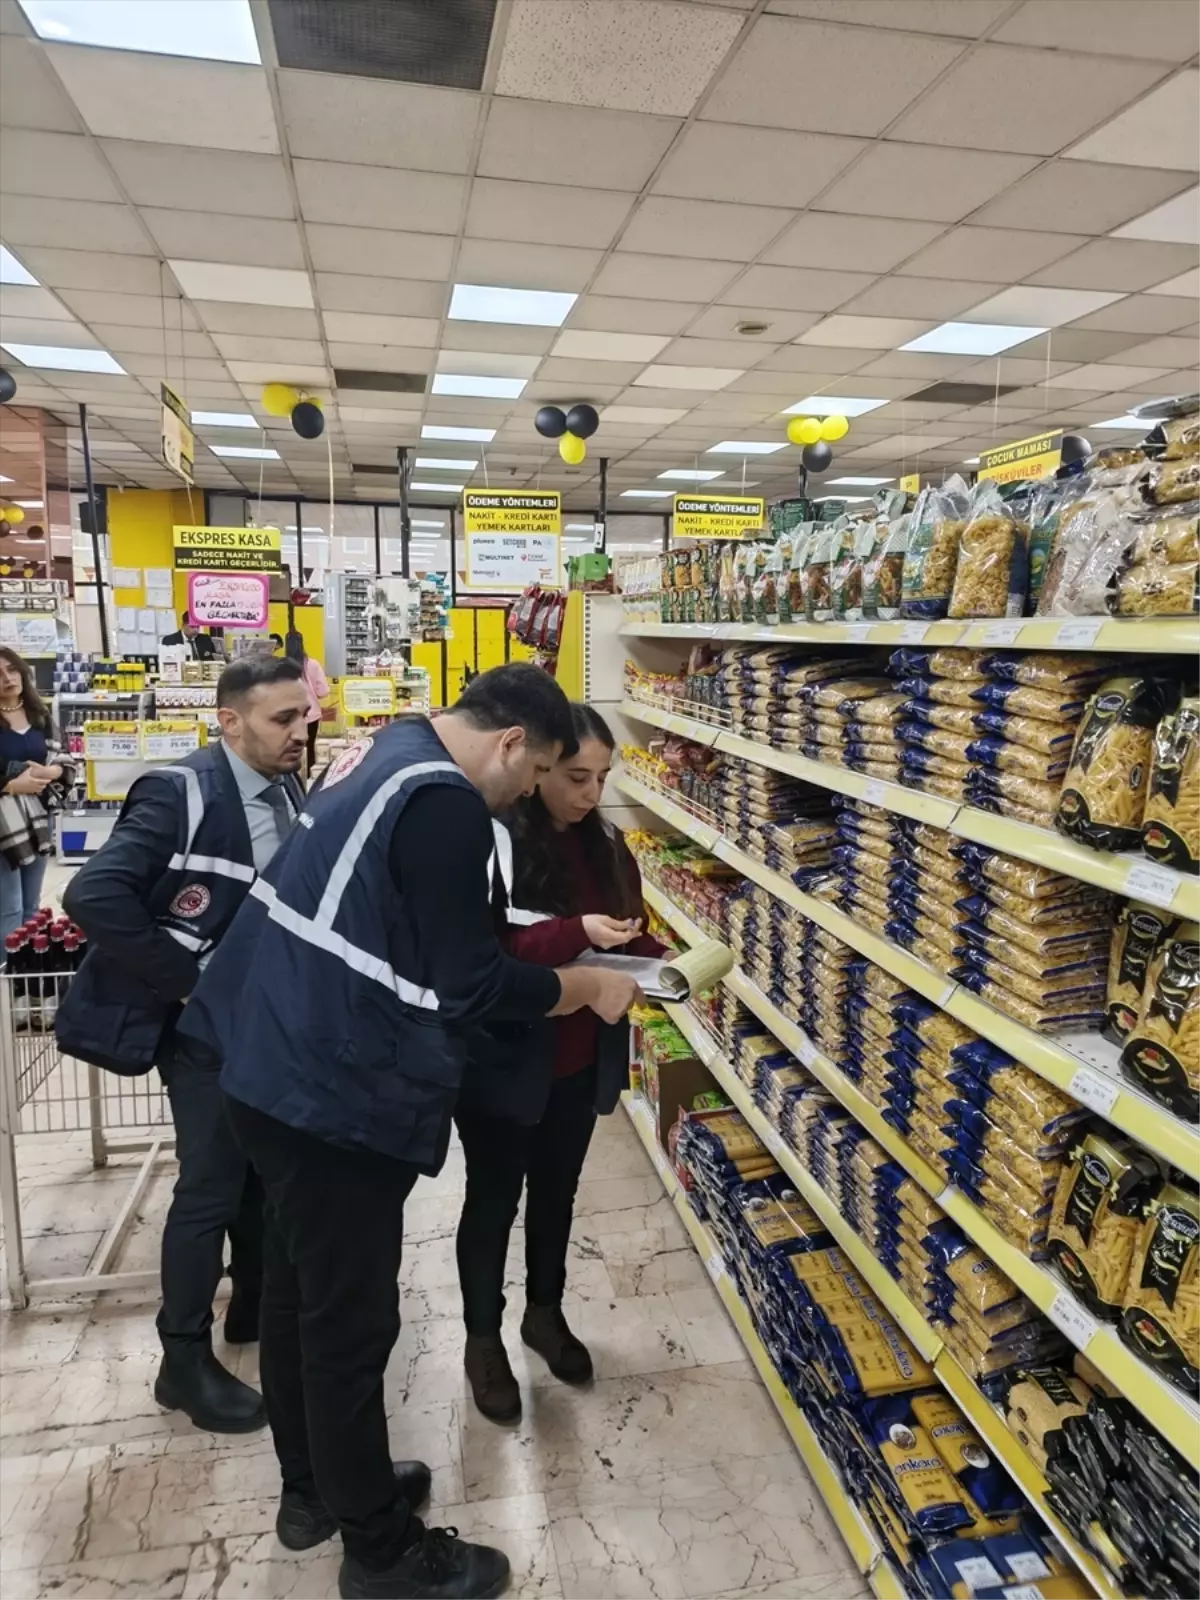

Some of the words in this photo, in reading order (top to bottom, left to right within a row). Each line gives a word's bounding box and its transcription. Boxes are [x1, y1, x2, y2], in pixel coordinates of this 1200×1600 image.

[987, 449, 1015, 467] ÇOCUK
[1017, 439, 1052, 458] MAMASI
[991, 463, 1042, 482] İSKÜVİLER
[468, 496, 500, 506] ÖDEME
[502, 497, 557, 507] YÖNTEMLERİ
[678, 501, 707, 511] ÖDEME
[708, 502, 759, 513] YÖNTEMLERİ
[469, 511, 496, 519] NAKİT
[504, 512, 530, 520] KREDİ
[532, 513, 557, 521] KARTI
[678, 516, 702, 525] NAKİT
[710, 517, 734, 526] KREDİ
[736, 518, 760, 527] KARTI
[477, 523, 507, 531] YEMEK
[510, 523, 551, 532] KARTLARI
[684, 527, 712, 536] YEMEK
[180, 531, 235, 546] EKSPRES
[238, 533, 272, 547] KASA
[192, 550, 224, 558] SADECE
[226, 551, 250, 559] NAKİT
[195, 600, 207, 608] EN
[210, 600, 236, 608] FAZLA
[895, 1458, 941, 1475] ankara
